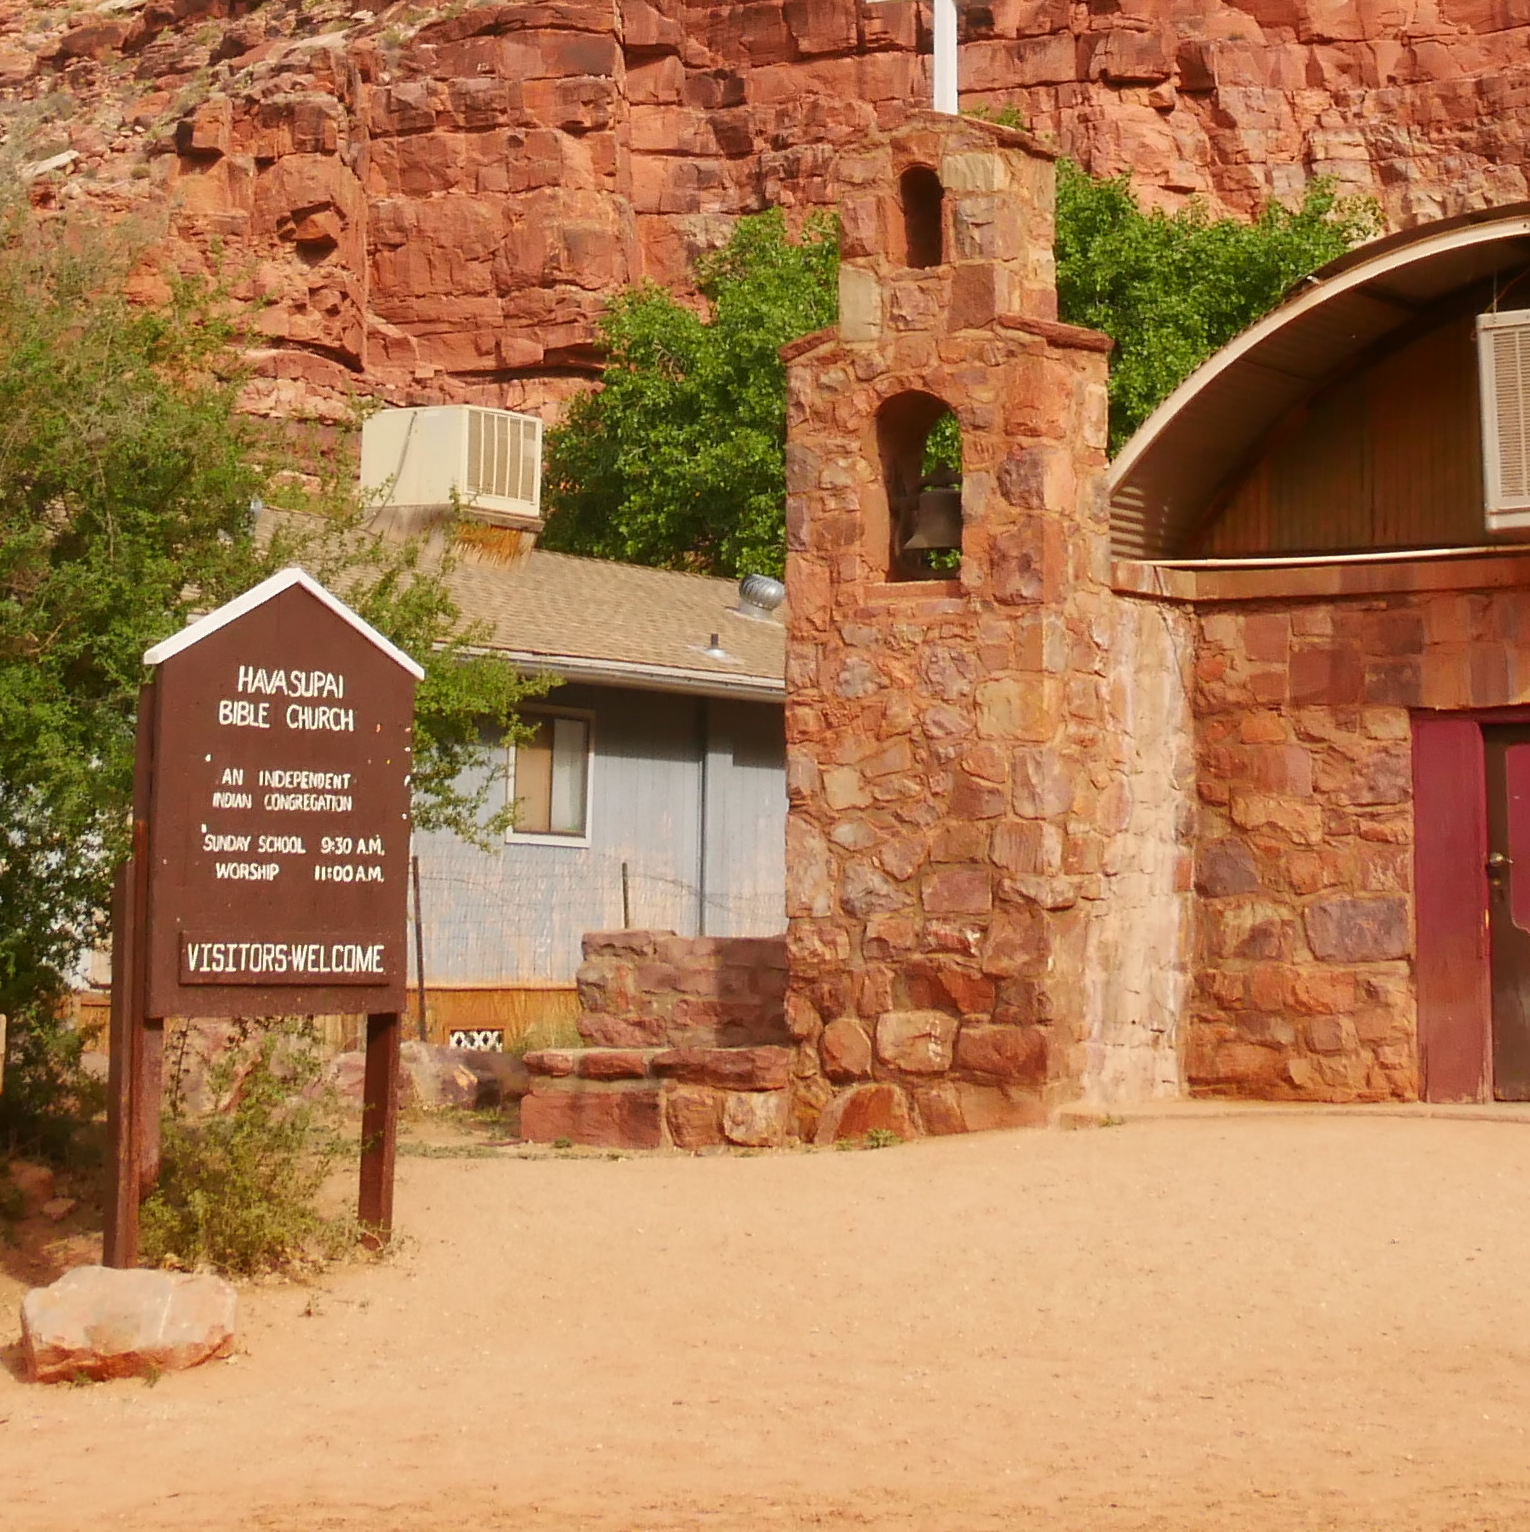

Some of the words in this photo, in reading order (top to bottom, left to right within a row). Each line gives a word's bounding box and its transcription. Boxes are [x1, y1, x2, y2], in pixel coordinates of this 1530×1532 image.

[238, 665, 344, 699] HAVASUPAI
[219, 700, 270, 729] BIBLE
[286, 704, 355, 732] CHURCH
[222, 768, 244, 786] AN
[259, 770, 351, 789] INDEPENDENT
[212, 792, 252, 809] INDIAN
[264, 793, 353, 812] CONGREGATION
[203, 834, 252, 852] SUNDAY
[258, 835, 306, 854] SCHOOL
[320, 837, 352, 855] 9:30
[216, 862, 280, 881] WORSHIP
[314, 865, 353, 882] 11:00
[355, 865, 385, 883] A.M.
